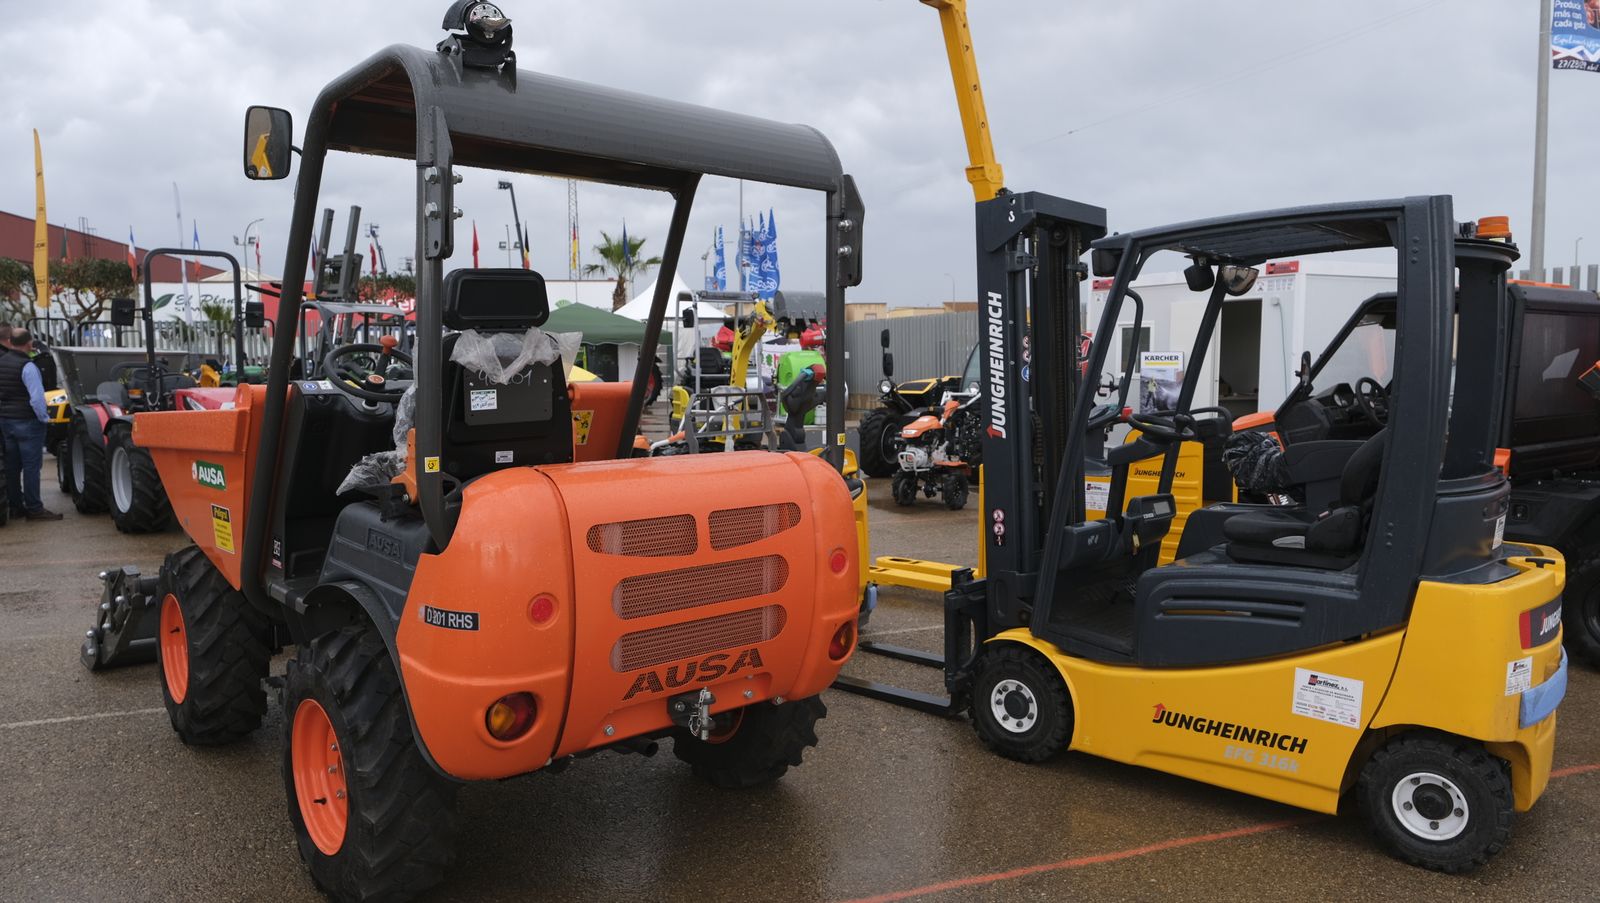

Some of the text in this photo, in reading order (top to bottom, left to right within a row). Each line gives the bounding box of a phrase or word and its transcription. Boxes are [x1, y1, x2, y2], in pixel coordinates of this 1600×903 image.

[987, 291, 1007, 439] JUNGHEINRICH
[198, 465, 225, 487] AUSA
[370, 533, 400, 558] AUSA
[448, 613, 473, 629] RHS
[622, 648, 764, 701] AUSA
[1152, 710, 1308, 754] JUNGHEINRICH
[1223, 744, 1299, 773] EFG 316k
